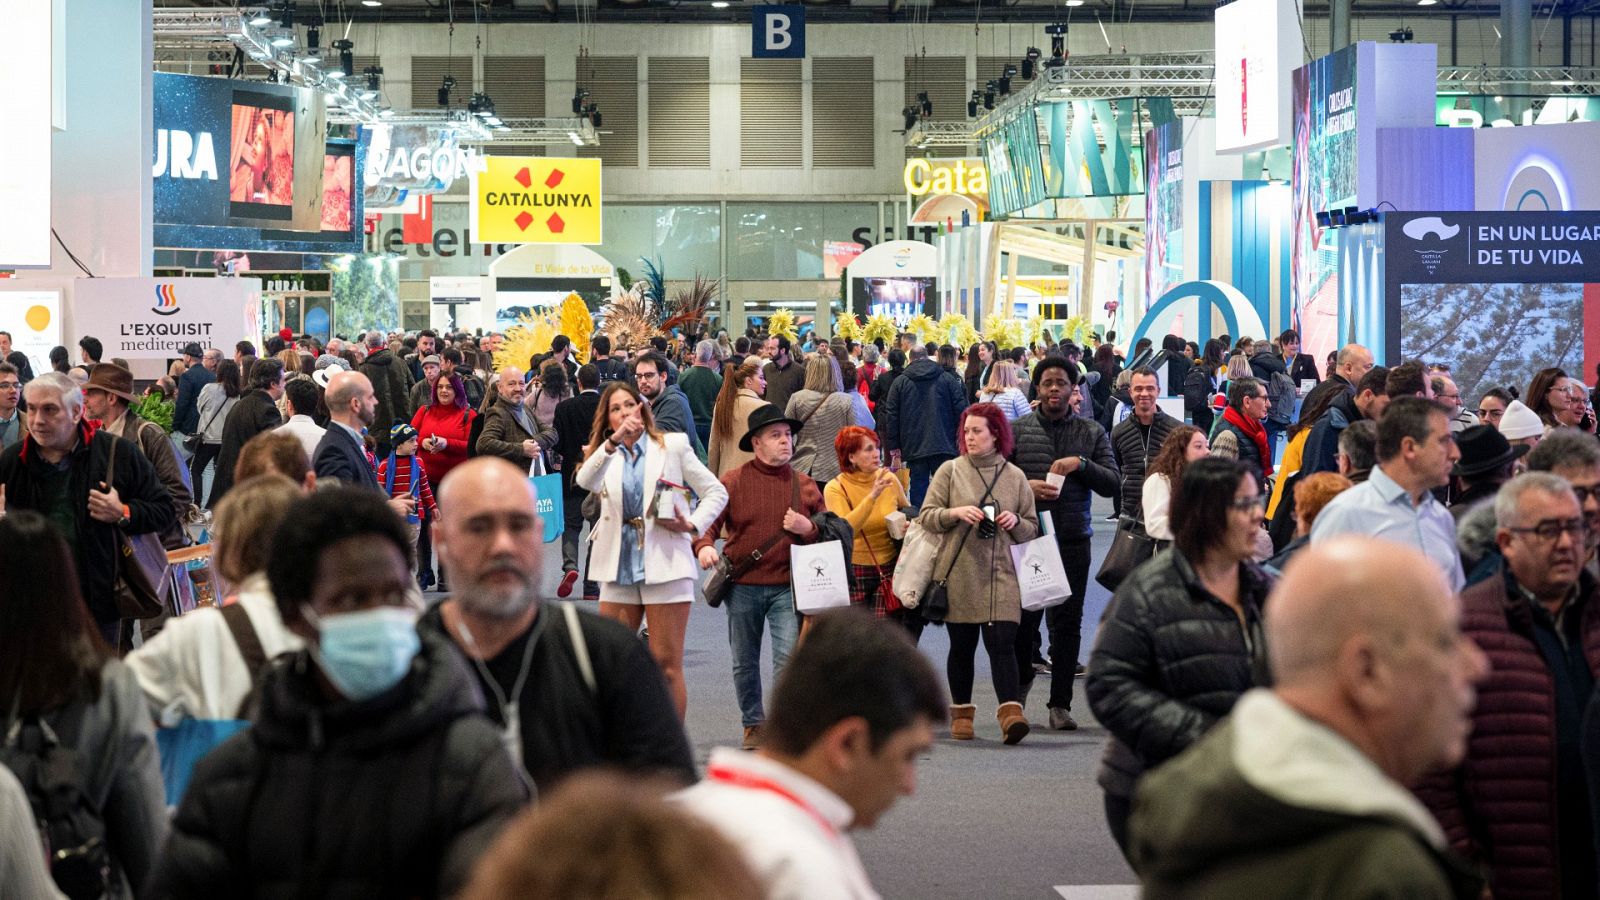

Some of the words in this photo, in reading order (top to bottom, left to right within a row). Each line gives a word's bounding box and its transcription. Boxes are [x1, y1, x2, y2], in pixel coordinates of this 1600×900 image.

[765, 13, 793, 51] B
[903, 157, 988, 196] Cata
[486, 192, 593, 208] CATALUNYA
[1478, 226, 1503, 241] EN
[1508, 226, 1536, 241] UN
[1478, 250, 1503, 265] DE
[1508, 250, 1533, 265] TU
[1538, 250, 1584, 265] VIDA
